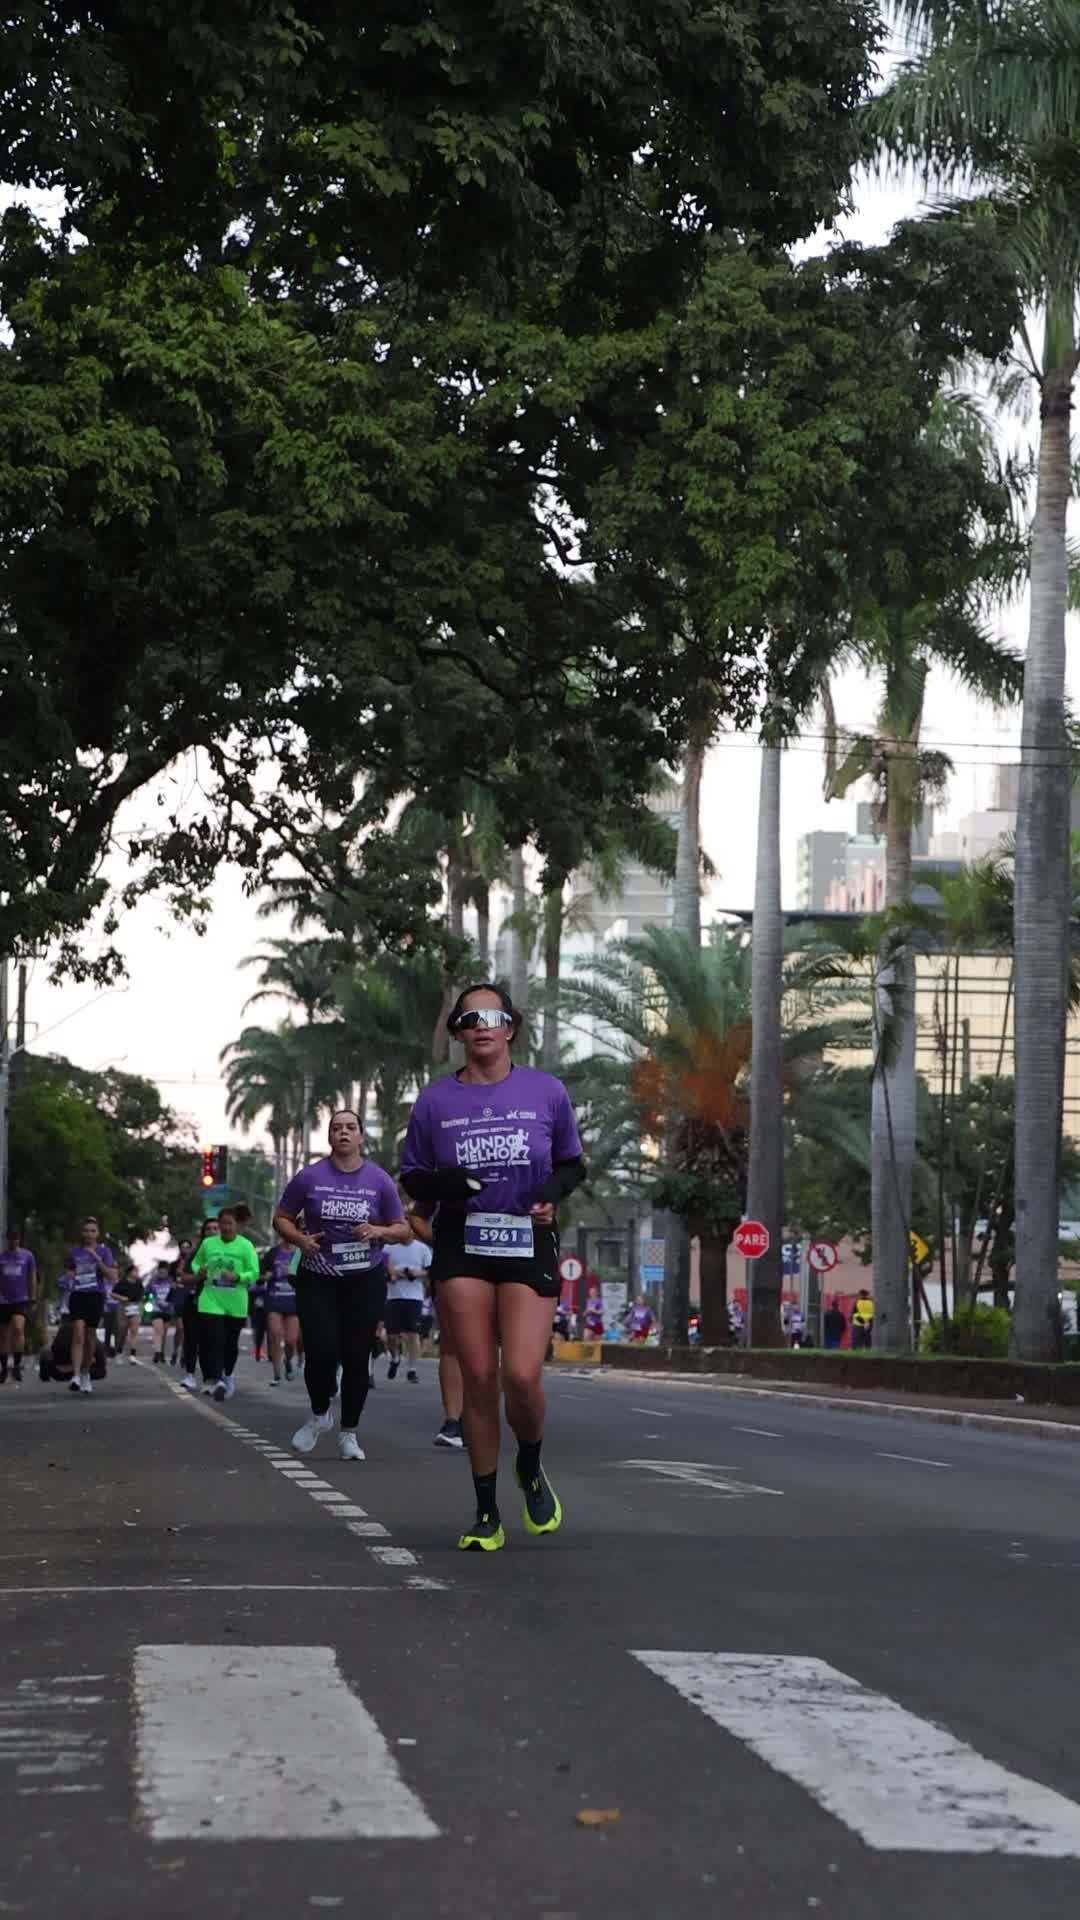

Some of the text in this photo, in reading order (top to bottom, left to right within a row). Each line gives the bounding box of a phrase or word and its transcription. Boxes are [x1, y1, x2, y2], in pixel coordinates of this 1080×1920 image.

[456, 1134, 518, 1154] MUNDO
[480, 1228, 517, 1242] 5961
[736, 1234, 766, 1246] PARE
